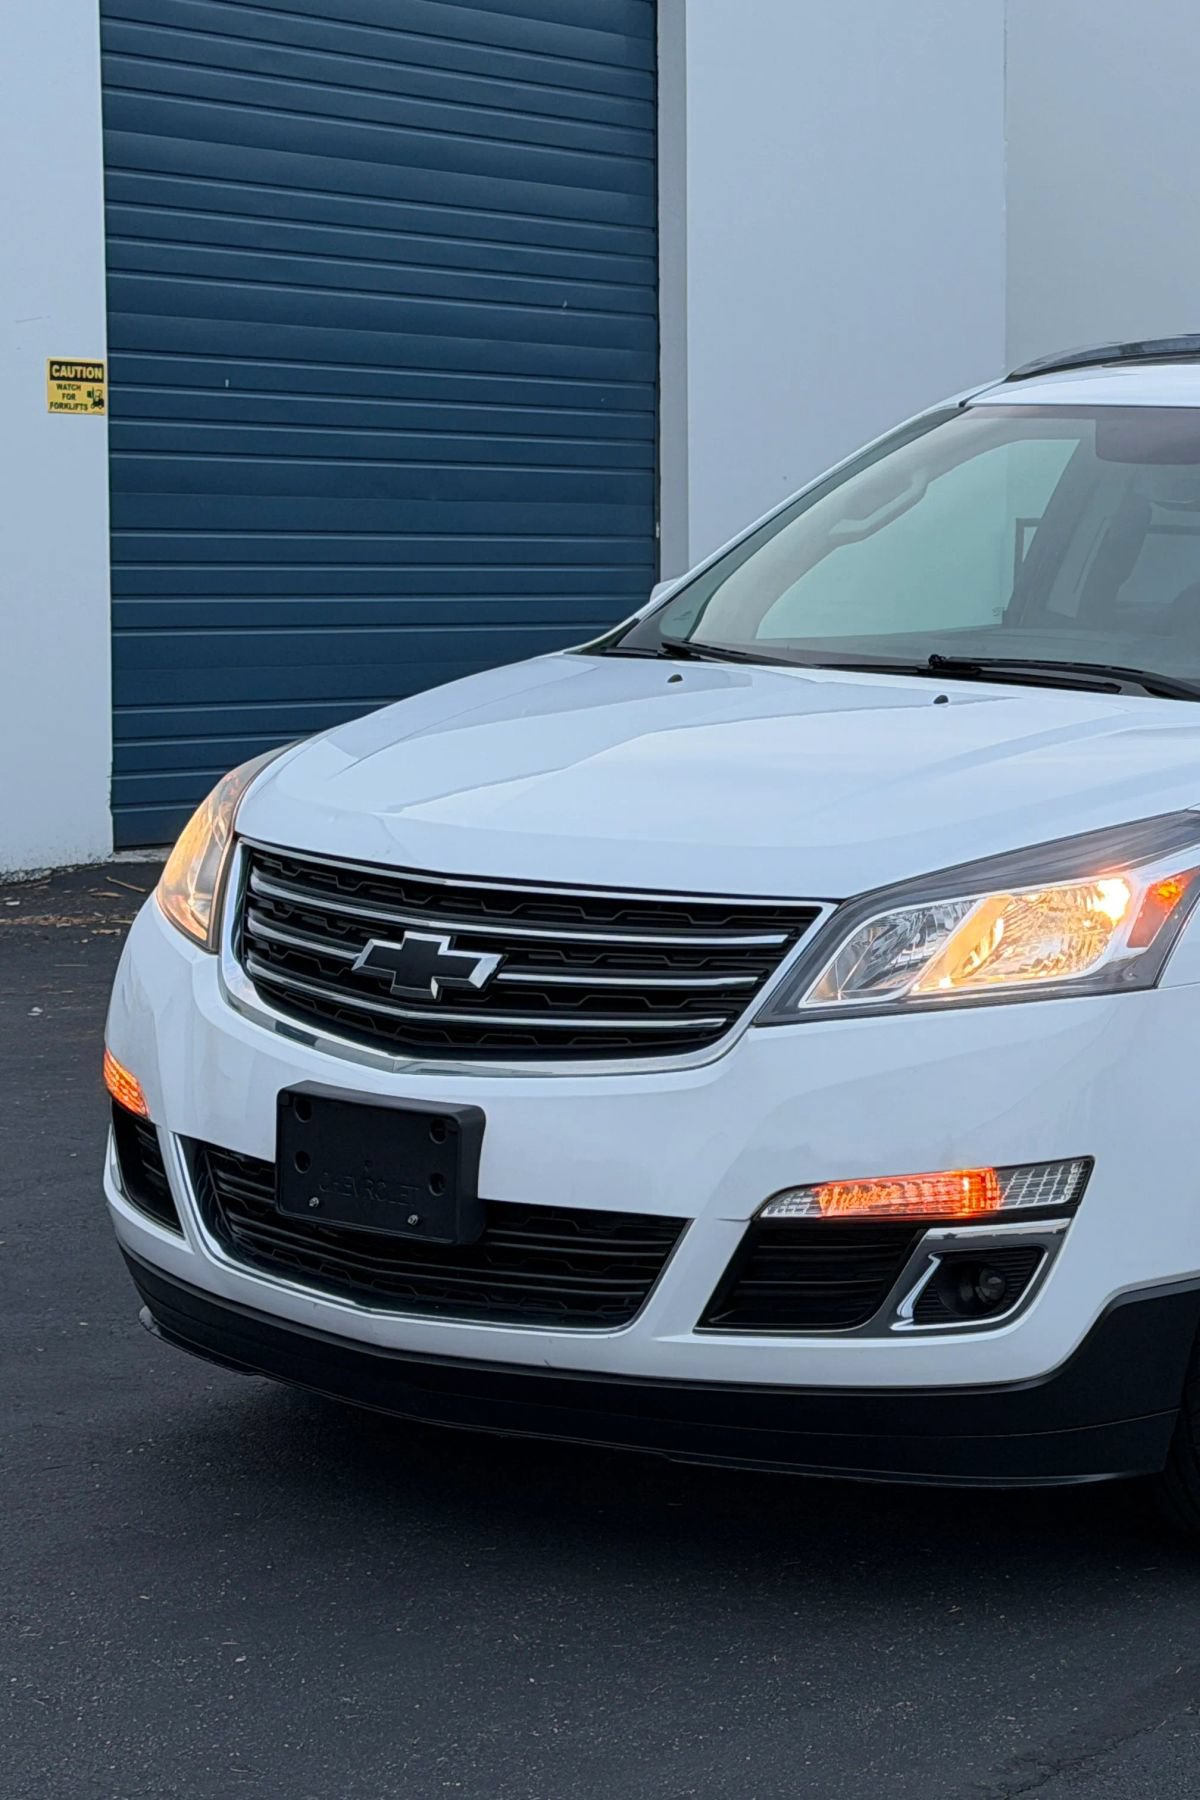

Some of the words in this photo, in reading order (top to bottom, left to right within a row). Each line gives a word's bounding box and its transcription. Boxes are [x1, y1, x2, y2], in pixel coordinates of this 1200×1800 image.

[52, 364, 103, 380] CAUTION
[56, 383, 81, 391] WATCH
[61, 393, 76, 401] FOR
[49, 402, 89, 411] FORKLIFTS
